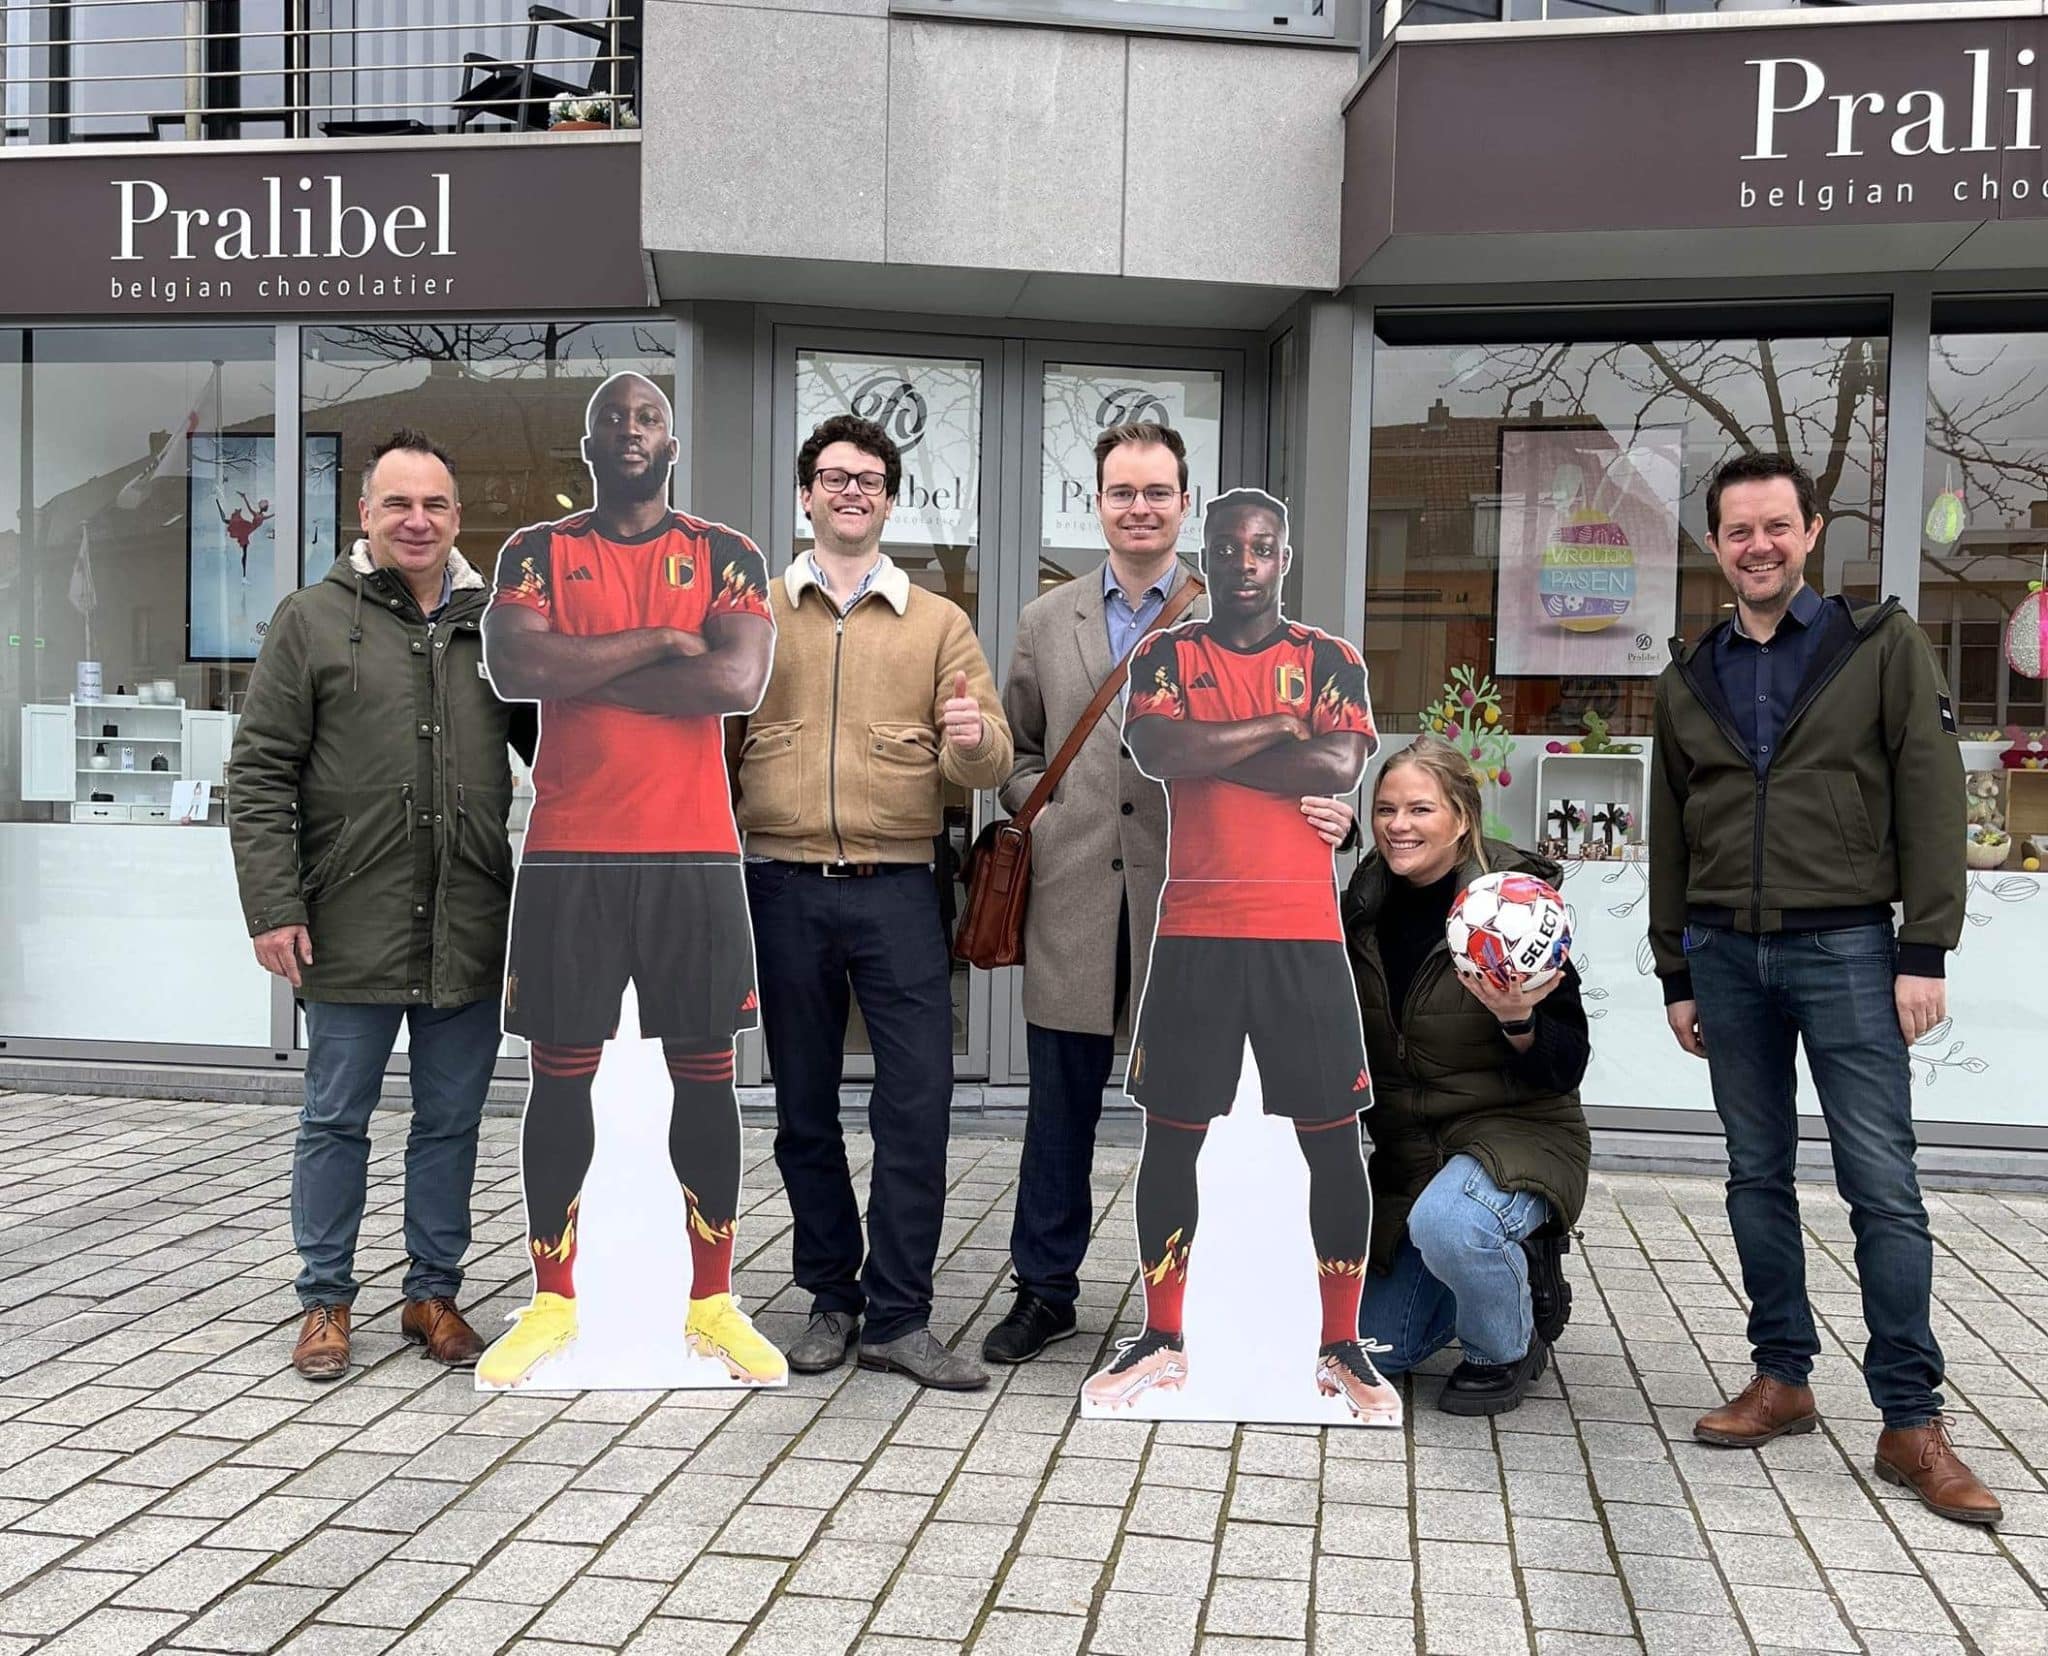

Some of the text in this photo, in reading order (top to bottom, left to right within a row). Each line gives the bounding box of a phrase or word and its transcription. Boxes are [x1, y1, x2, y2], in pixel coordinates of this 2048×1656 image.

[1740, 179, 1913, 211] belgian
[110, 173, 457, 260] Pralibel
[110, 274, 454, 302] belgian chocolatier
[1551, 570, 1628, 593] PASEN
[1520, 904, 1559, 968] SELECT
